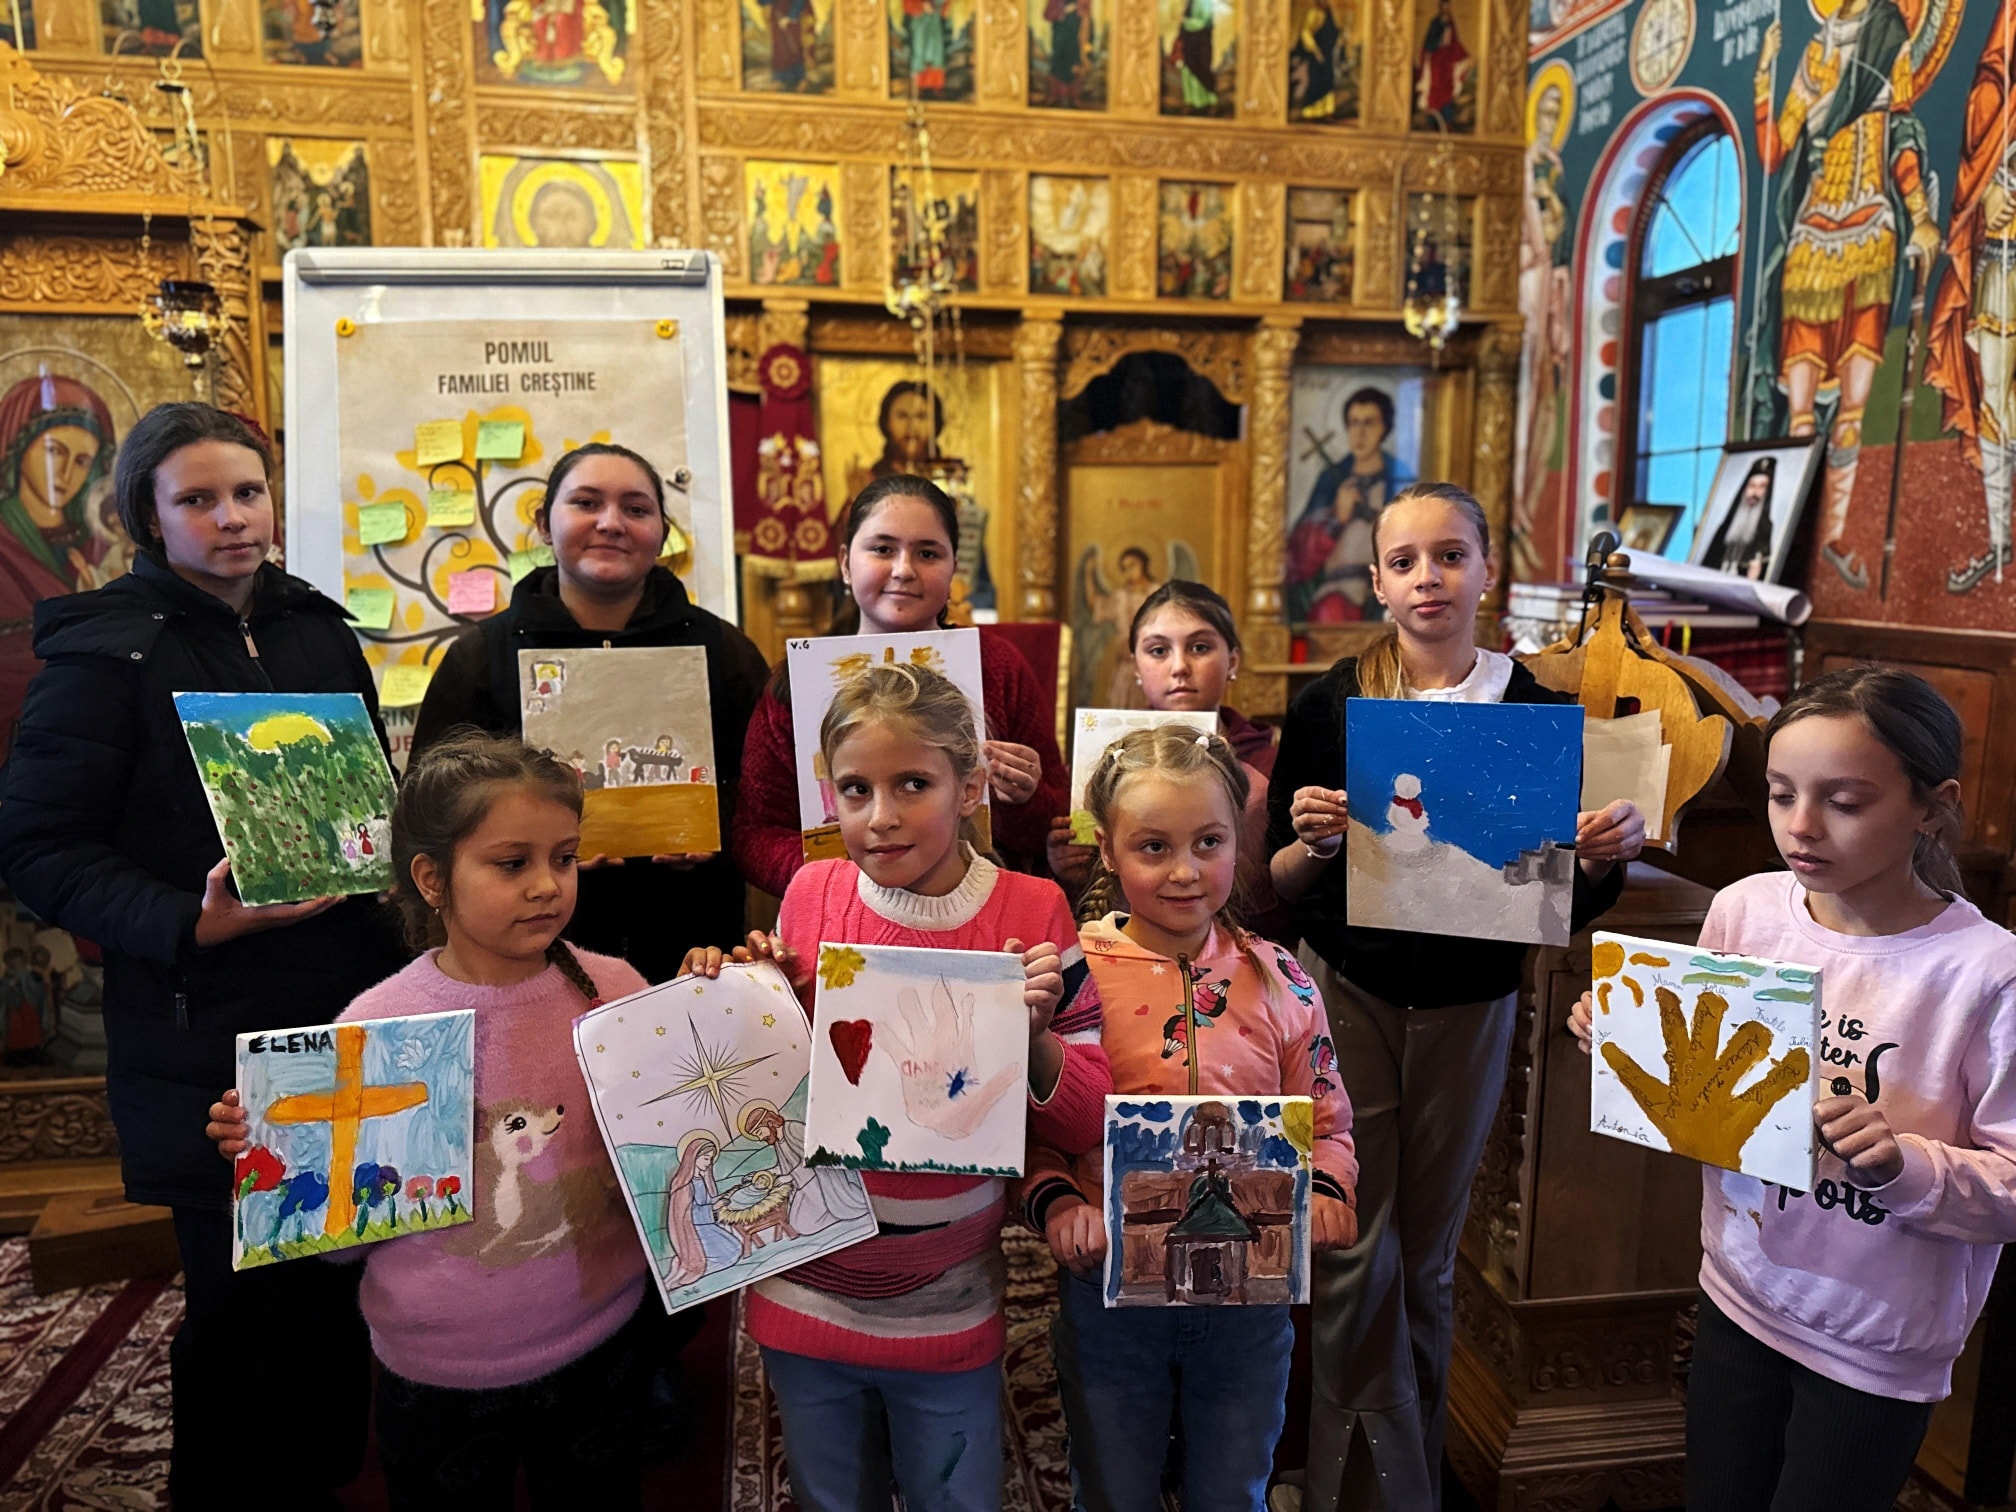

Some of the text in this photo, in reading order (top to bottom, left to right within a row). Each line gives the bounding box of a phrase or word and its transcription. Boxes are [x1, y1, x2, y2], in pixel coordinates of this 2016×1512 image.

[485, 341, 553, 364] POMUL
[438, 371, 597, 397] FAMILIEI CREȘTINE
[1838, 1013, 1869, 1041] is
[248, 1030, 335, 1054] ELENA
[1596, 1113, 1651, 1143] Antonia
